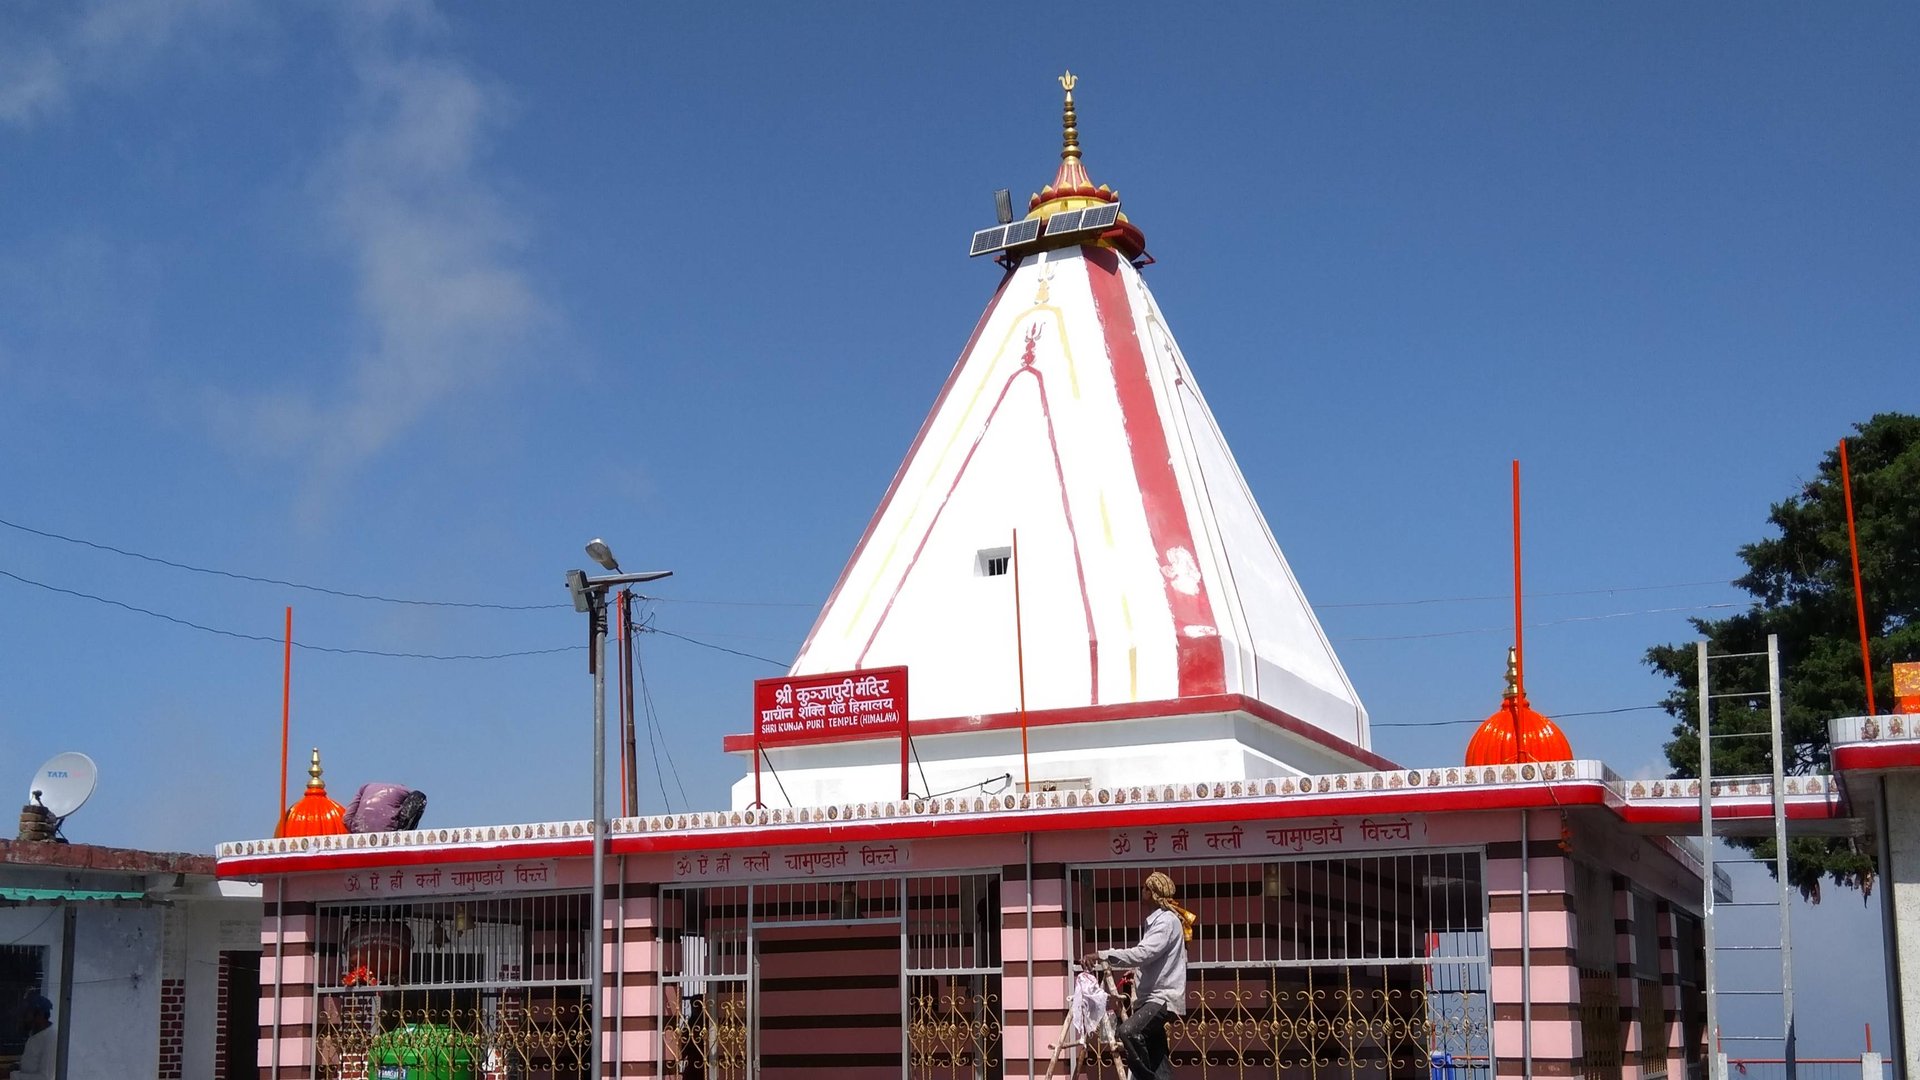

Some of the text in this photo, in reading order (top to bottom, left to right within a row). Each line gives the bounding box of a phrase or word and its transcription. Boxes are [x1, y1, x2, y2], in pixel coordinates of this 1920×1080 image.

[775, 676, 889, 706] श्री कुञ्जापुरी मंदिर
[761, 698, 893, 723] प्राचीन शक्ति पीठ हिमालय
[761, 710, 900, 734] SHRI KUNJA PURI TEMPLE (HIMALAYA)
